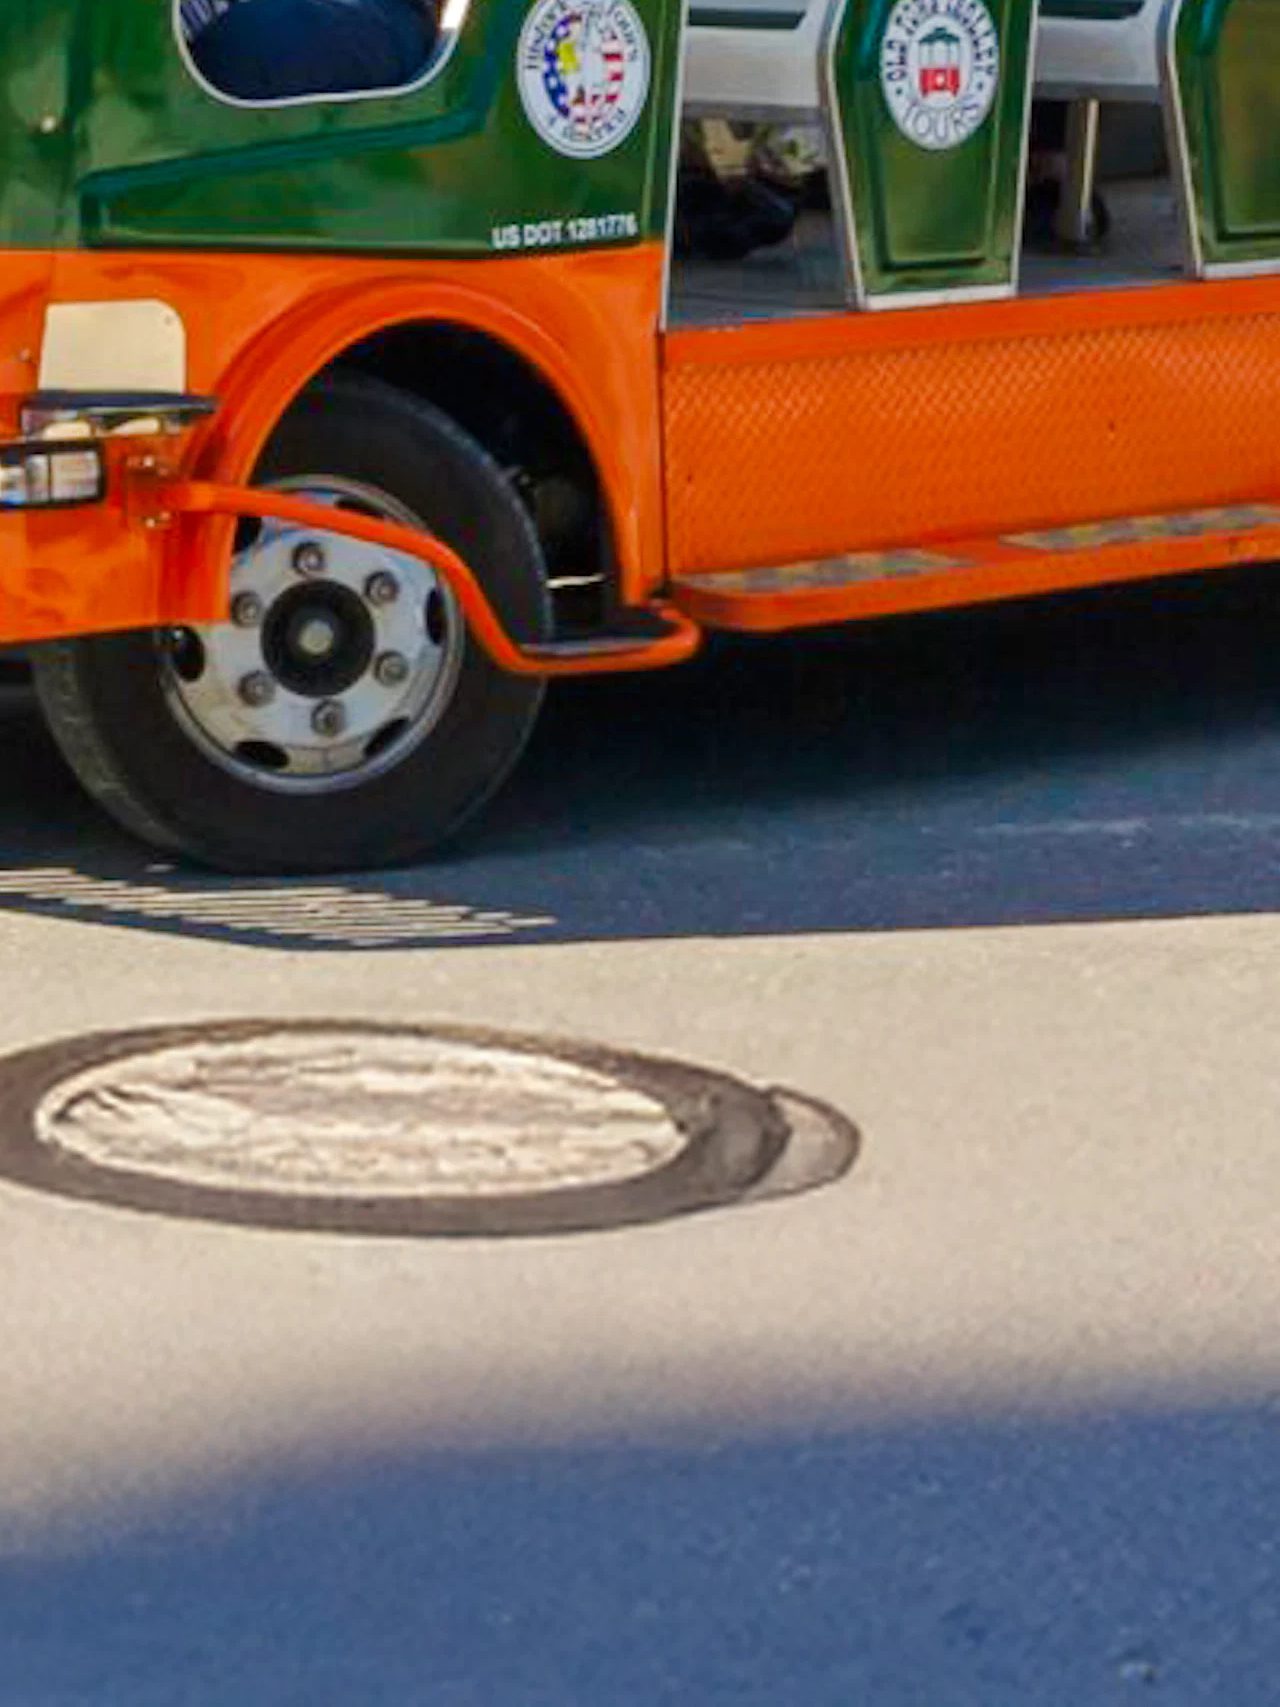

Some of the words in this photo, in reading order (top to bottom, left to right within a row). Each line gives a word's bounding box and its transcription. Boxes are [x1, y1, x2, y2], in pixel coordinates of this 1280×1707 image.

[886, 40, 908, 82] OLD
[902, 94, 982, 141] TOURS
[491, 224, 520, 250] US
[523, 220, 563, 247] DOT
